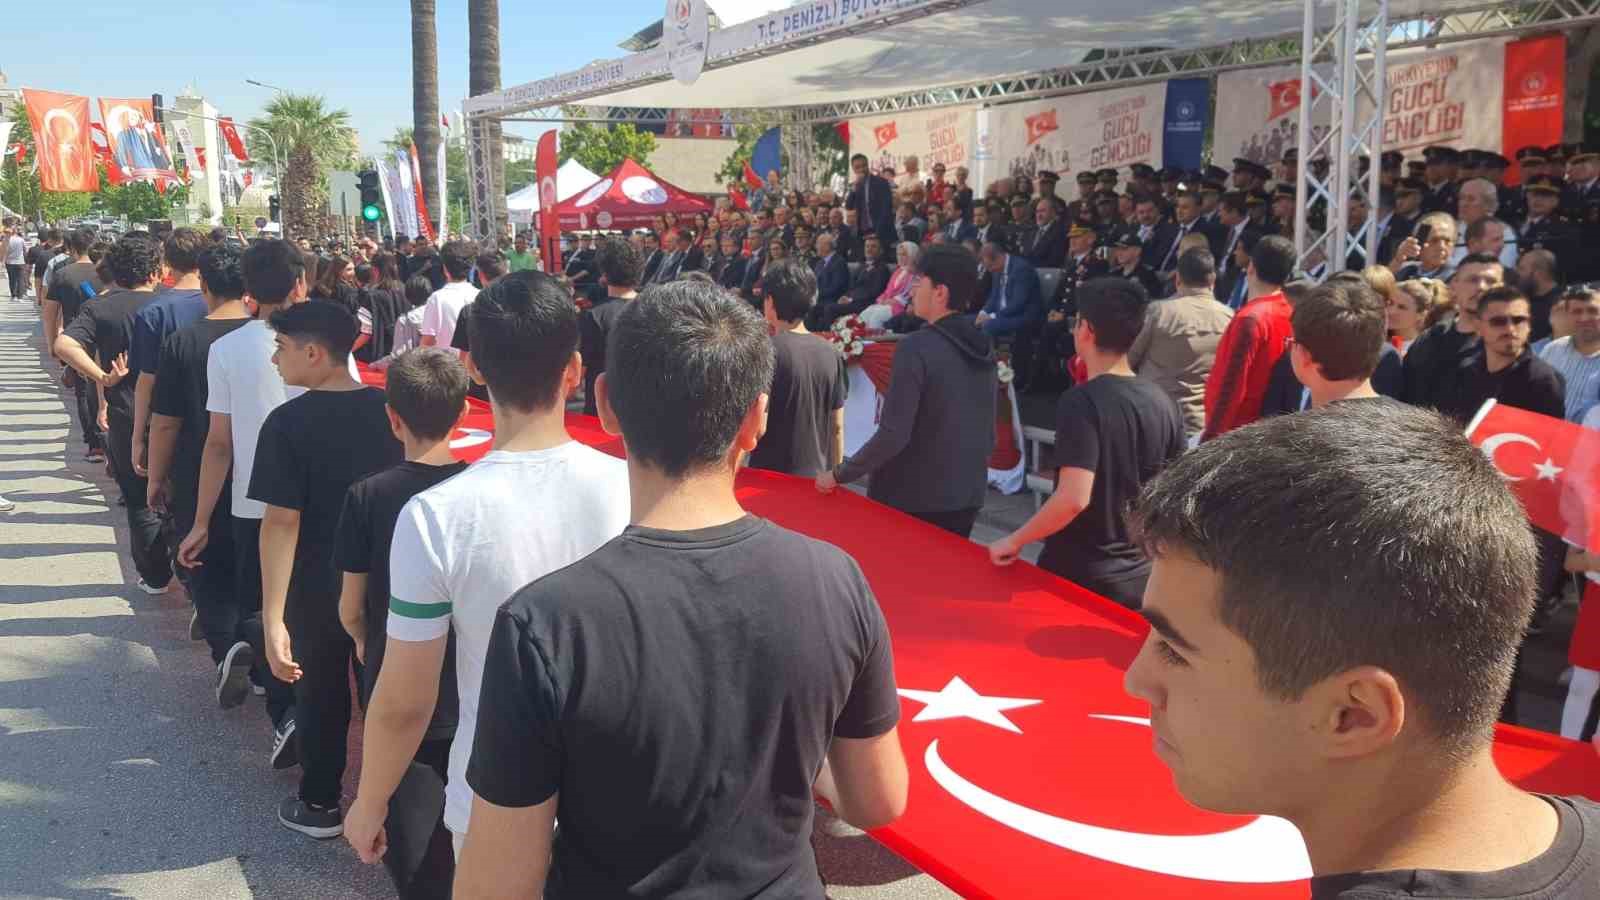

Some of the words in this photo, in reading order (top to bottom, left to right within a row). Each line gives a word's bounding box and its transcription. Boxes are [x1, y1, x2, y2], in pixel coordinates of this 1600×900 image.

[758, 20, 780, 39] T.C.
[1390, 56, 1458, 83] ÜRKİYE'NİN
[1391, 78, 1447, 113] GÜCÜ
